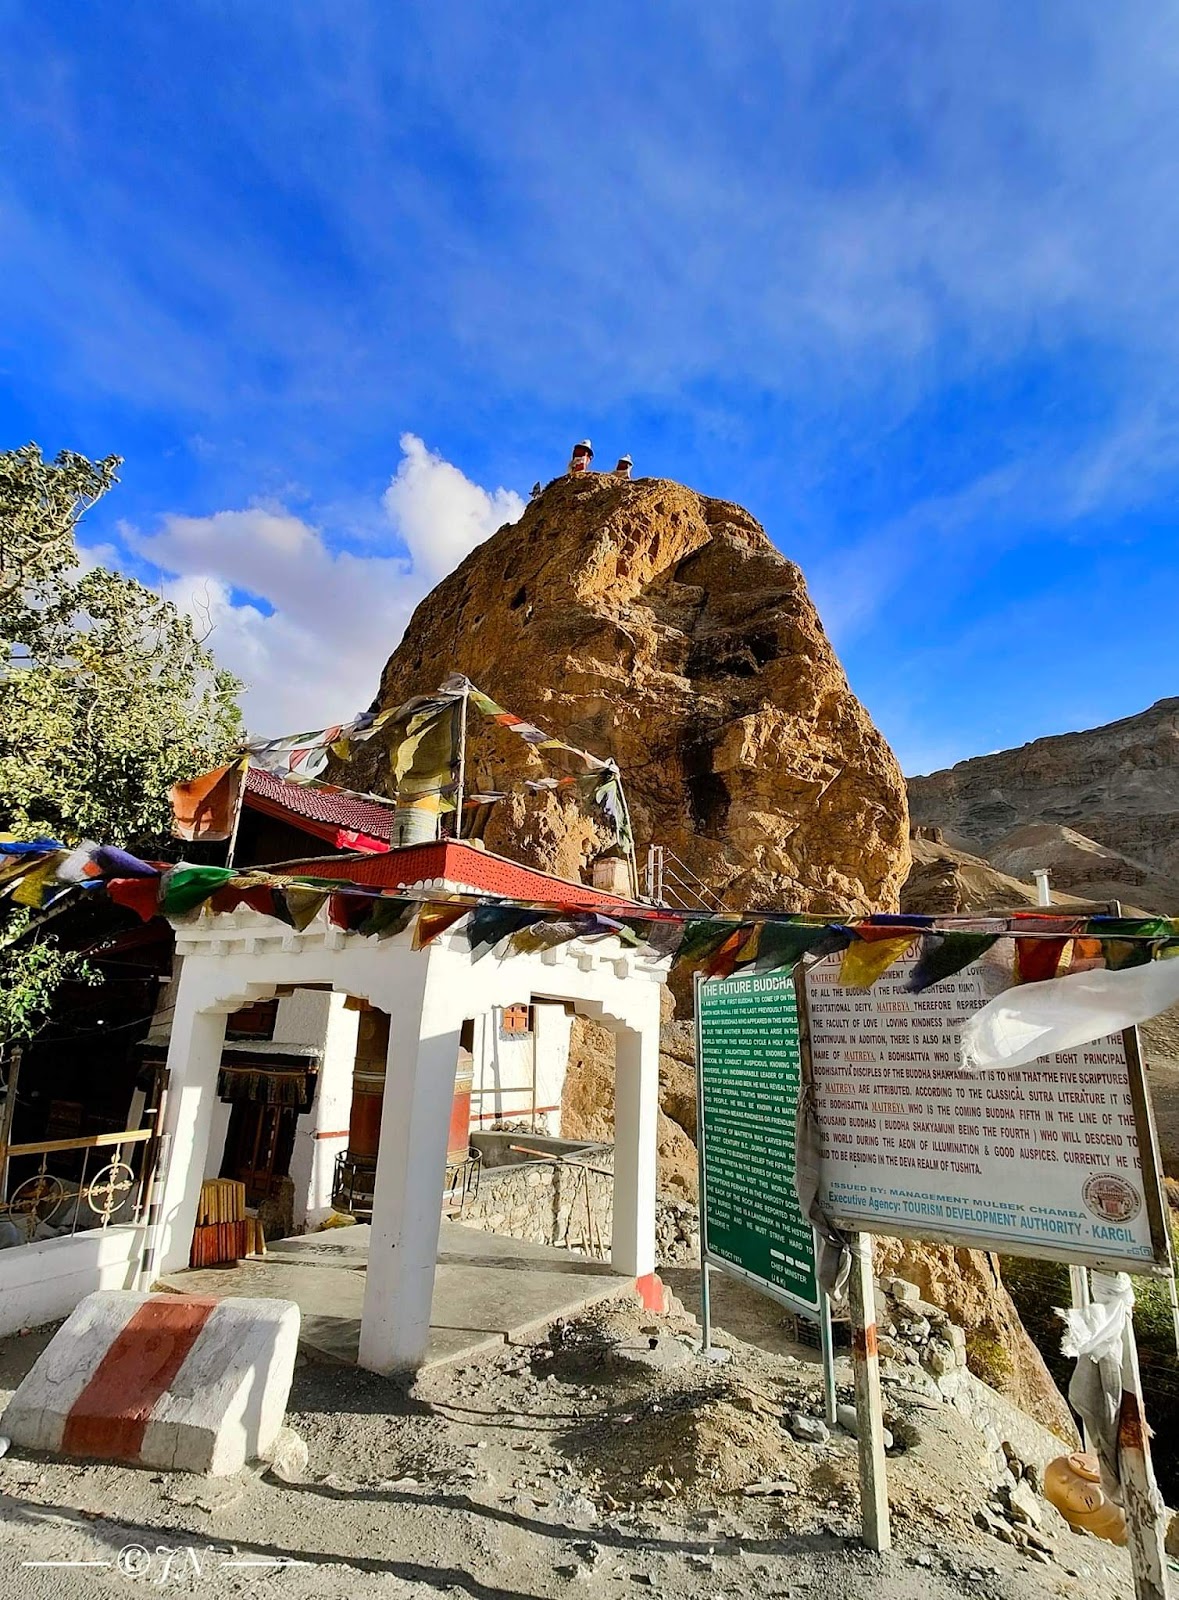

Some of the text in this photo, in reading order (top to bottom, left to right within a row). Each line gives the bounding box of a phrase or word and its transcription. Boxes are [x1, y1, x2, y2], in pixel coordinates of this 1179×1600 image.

[703, 976, 794, 996] THE FUTURE BUDDHA
[821, 989, 830, 997] ALL
[833, 988, 843, 996] THE
[846, 987, 871, 996] BUDDHAS
[879, 986, 890, 995] THE
[958, 983, 975, 992] MIND
[812, 1004, 850, 1012] MEDITATIONAL
[876, 1002, 910, 1011] MAITREYA
[914, 1001, 951, 1010] THEREFORE
[853, 1019, 860, 1027] OF
[863, 1019, 878, 1027] LOVE
[886, 1019, 908, 1027] LOVING
[912, 1018, 943, 1027] KINDNESS
[849, 1035, 855, 1043] IN
[859, 1035, 887, 1046] ADDITION,
[890, 1035, 910, 1044] THERE
[913, 1035, 919, 1044] IS
[922, 1035, 938, 1044] ALSO
[942, 1035, 951, 1044] AN
[1106, 1035, 1122, 1044] THE
[814, 1051, 829, 1059] NAME
[833, 1051, 840, 1059] OF
[843, 1051, 875, 1060] MAITREYA
[879, 1052, 884, 1060] A
[888, 1052, 930, 1061] BODHISATTVA
[934, 1052, 949, 1061] WHO
[954, 1052, 960, 1062] IS
[1055, 1053, 1078, 1064] EIGHT
[1084, 1054, 1126, 1065] PRINCIPAL
[814, 1066, 1128, 1084] BODHISATTVA DISCIPLES OF THE BUDDHA IT IS TO HIM THAT THE FIVE SCRIPTURES
[814, 1083, 1132, 1105] OF MAITREYA ARE ATTRIBUTED. ACCORDING TO THE CLASSICAL SUTRA LITERATURE IT IS
[816, 1099, 1136, 1126] THE BODHISATTVA MAITREYA WHO IS THE COMING BUDDHA FIFTH IN THE LINE OF THE
[816, 1115, 1139, 1147] THOUSAND BUDDHAS BUDDHA SHAKYAMUNI BEING THE FOURTH WHO WILL DESCEND TO
[819, 1132, 1142, 1169] HIS WORLD DURING THE AEON OF ILLUMINATION & GOOD AUSPICES. CURRENTLY HE IS
[831, 1150, 982, 1175] TO BE RESIDING IN THE DEVA REALM OF TUSHITA.
[831, 1182, 867, 1192] ISSUED
[890, 1189, 969, 1205] MANAGEMENT
[973, 1199, 1025, 1211] MULBEK
[1030, 1206, 1087, 1219] CHAMBA
[829, 1191, 866, 1206] Executive
[868, 1196, 901, 1214] Agency:
[902, 1200, 943, 1216] TOURISM
[945, 1206, 1016, 1227] DEVELOPMENT
[1020, 1216, 1083, 1236] AUTHORITY
[1092, 1225, 1136, 1243] KARGIL
